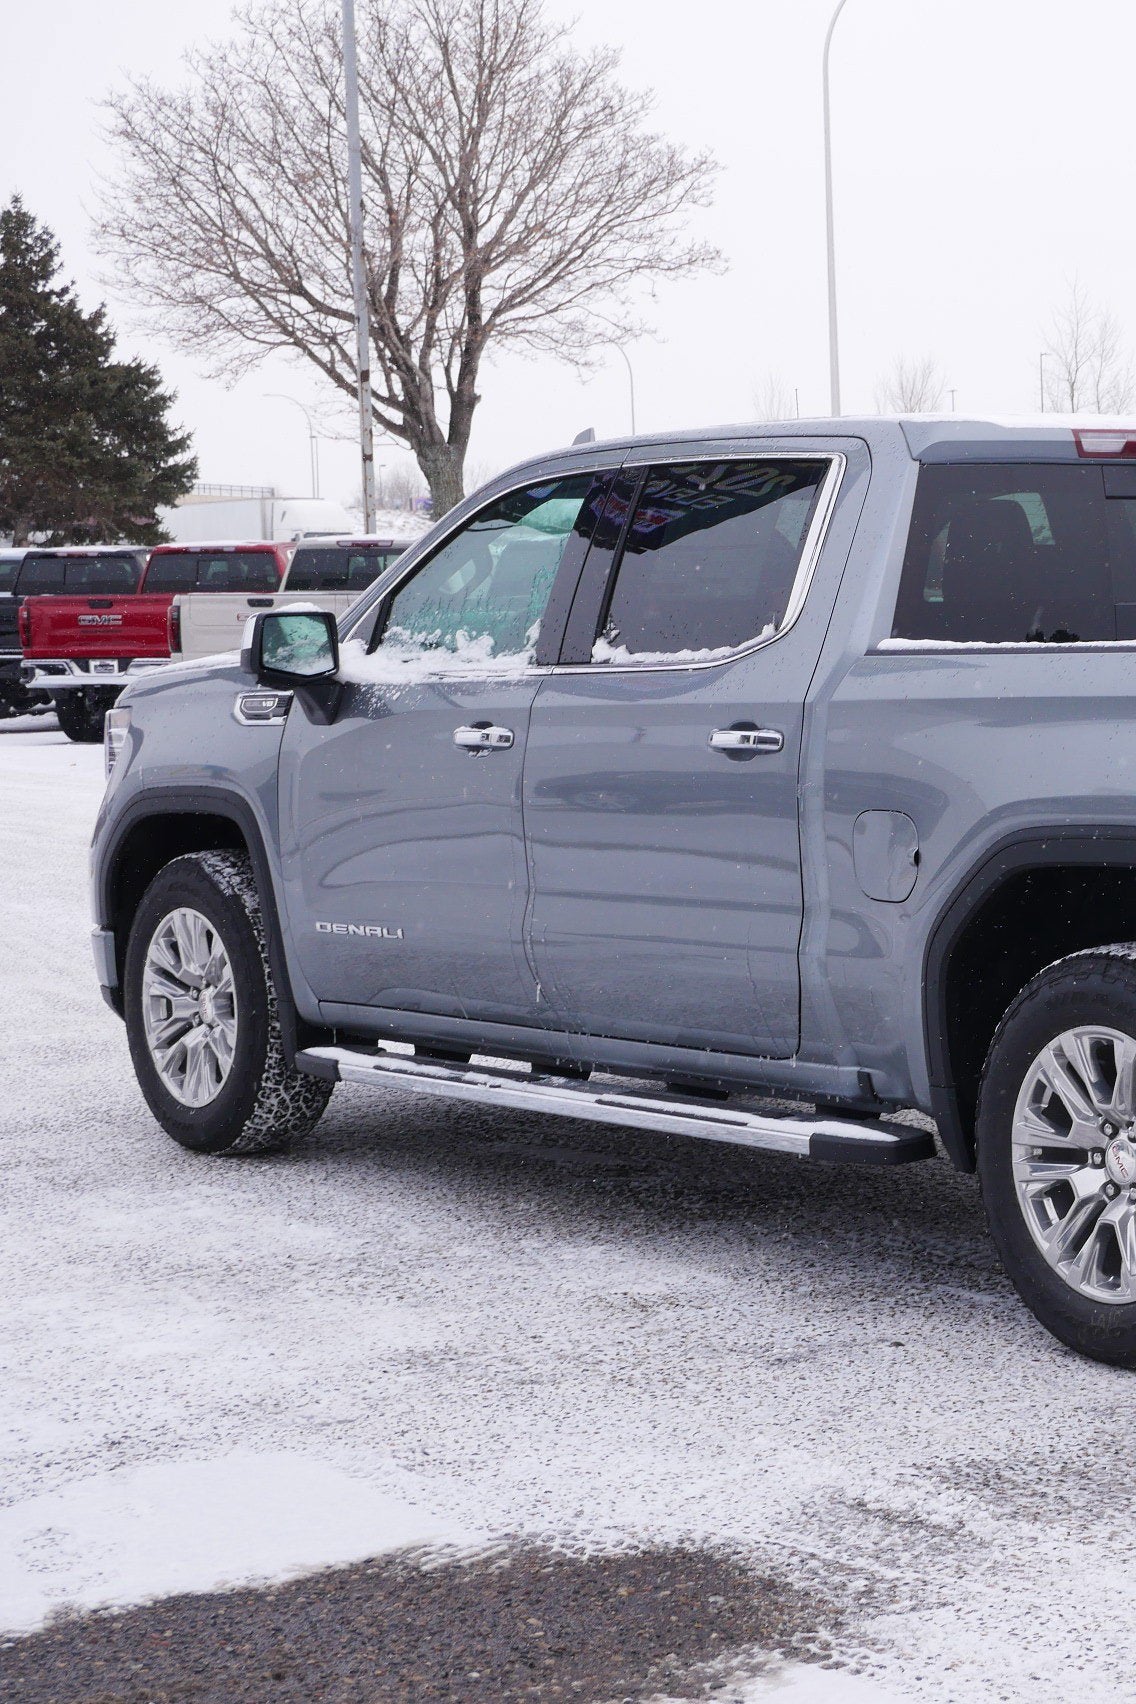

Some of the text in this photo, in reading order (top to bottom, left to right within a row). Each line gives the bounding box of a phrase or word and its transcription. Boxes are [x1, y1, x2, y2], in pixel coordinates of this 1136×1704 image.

[78, 614, 123, 626] GMC
[315, 921, 404, 940] DENALI
[1112, 1144, 1129, 1179] GMC
